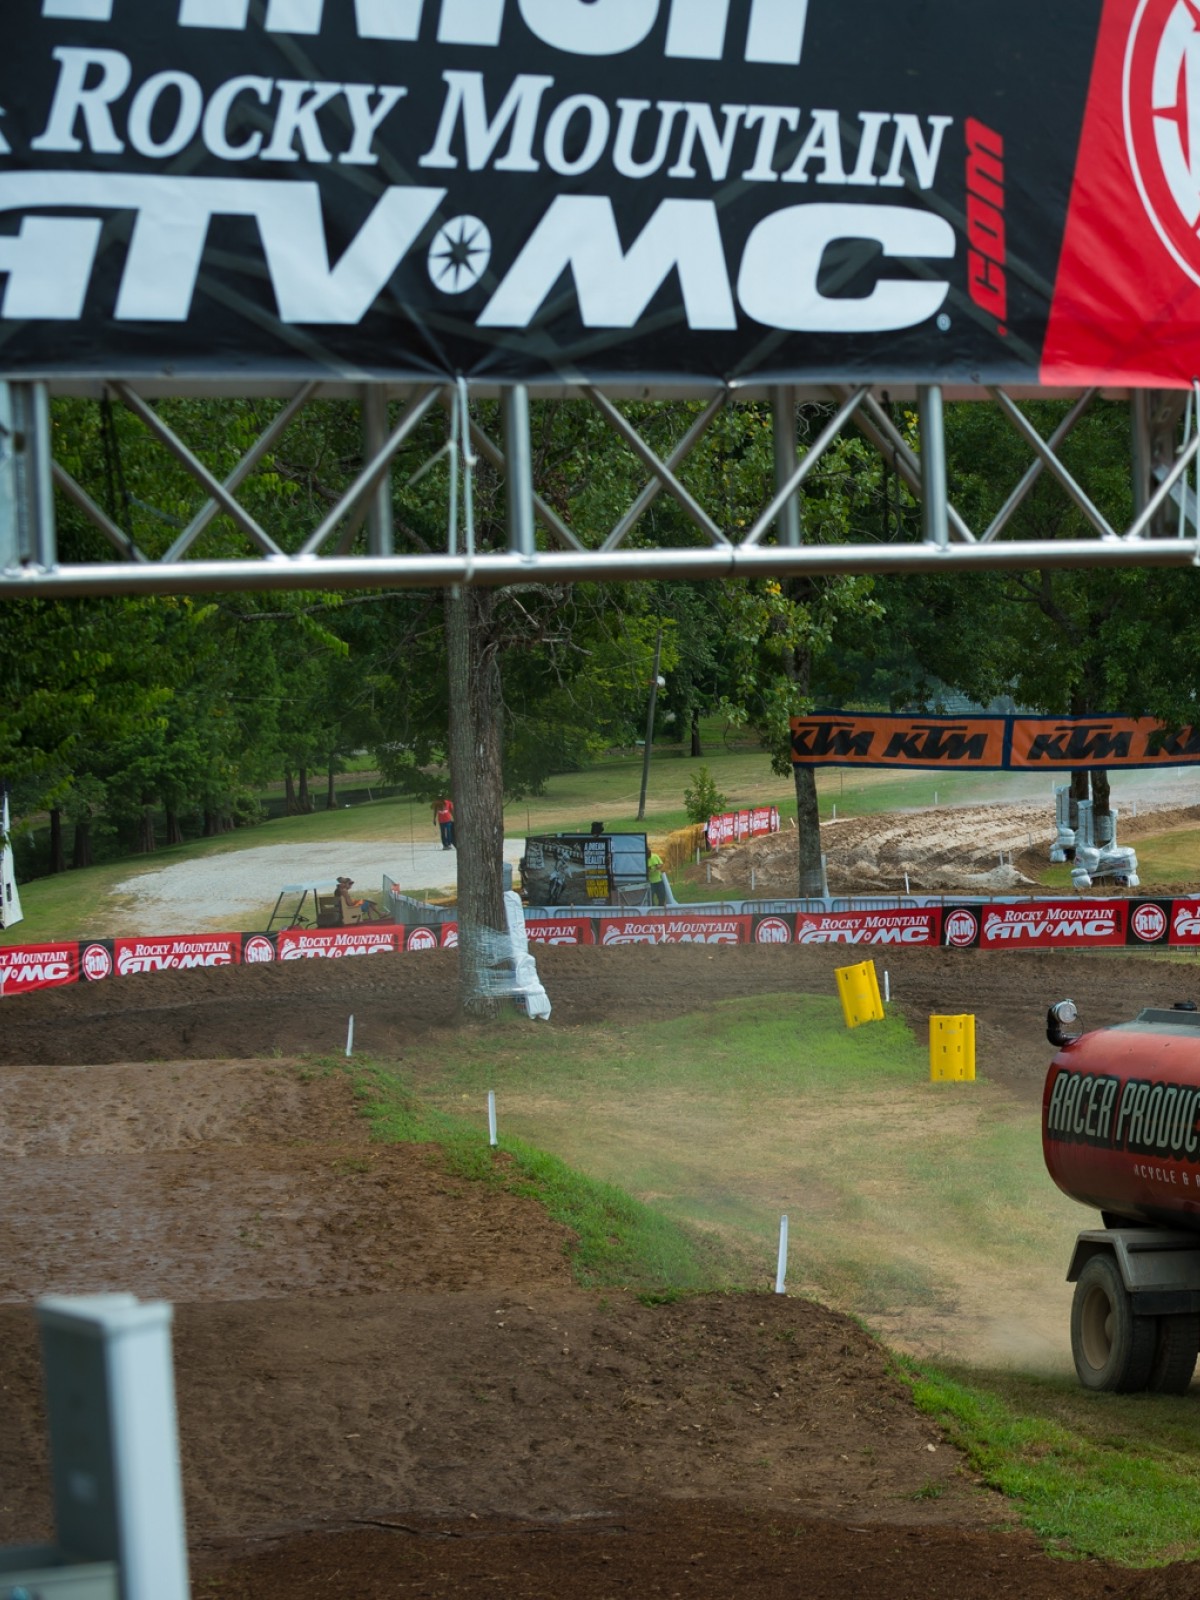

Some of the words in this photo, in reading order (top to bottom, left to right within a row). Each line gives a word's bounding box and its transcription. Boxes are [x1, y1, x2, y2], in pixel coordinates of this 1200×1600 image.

[31, 46, 407, 166] ROCKY
[419, 70, 953, 190] MOUNTAIN
[791, 722, 875, 756] KTM
[881, 725, 989, 760] KTM
[1026, 725, 1134, 760] KTM
[820, 918, 861, 930] ROCKY
[864, 915, 929, 928] MOUNTAIN
[1004, 910, 1044, 922] ROCKY
[1046, 908, 1114, 920] MOUNTAIN
[525, 926, 577, 937] OUNTAIN
[624, 923, 665, 934] ROCKY
[666, 922, 738, 933] MOUNTAIN
[299, 937, 332, 948] ROCKY
[334, 933, 393, 946] MOUNTAIN
[135, 944, 170, 956] ROCKY
[172, 941, 230, 954] MOUNTAIN
[10, 951, 68, 964] MOUNTAIN
[1048, 1072, 1117, 1138] RACER
